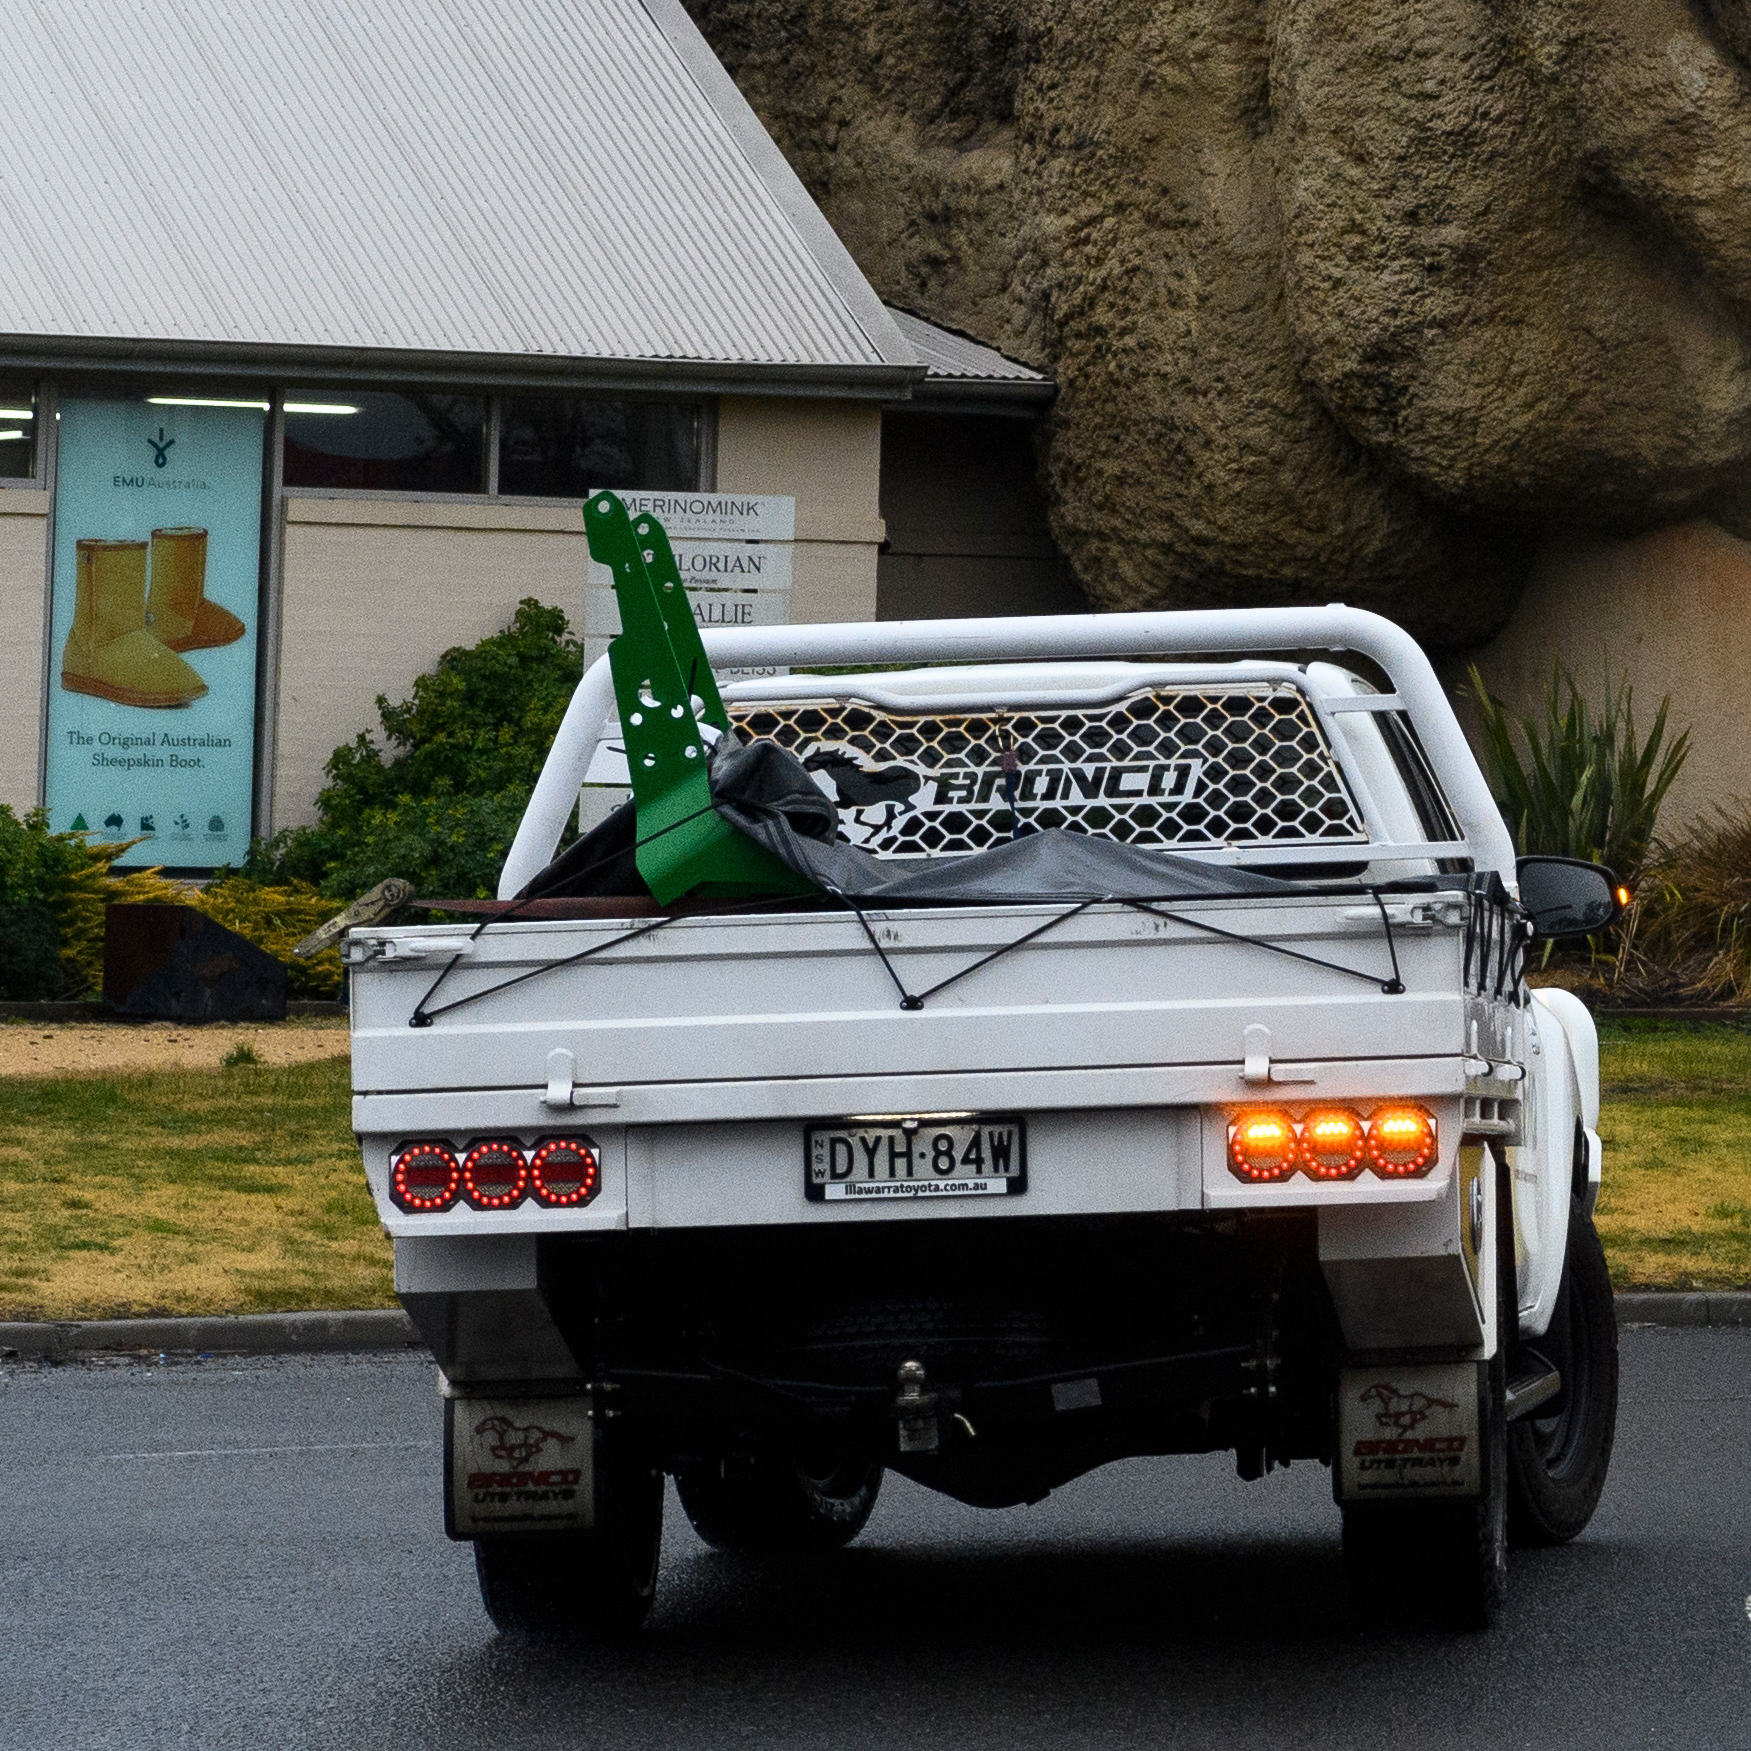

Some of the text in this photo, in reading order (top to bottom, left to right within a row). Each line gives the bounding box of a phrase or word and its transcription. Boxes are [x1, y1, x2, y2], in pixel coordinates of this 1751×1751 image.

[113, 476, 145, 488] EMU
[675, 553, 762, 575] LORIAN
[693, 603, 754, 624] ALLIE
[67, 731, 232, 749] The Original Australian
[92, 753, 206, 770] Sheepskin Boot.
[933, 763, 1194, 806] BRONCO
[814, 1138, 827, 1179] NSW
[844, 1181, 988, 1197] Illawarratoyota.com.au
[1354, 1437, 1466, 1456] BRONCO
[467, 1470, 581, 1489] BRONCO
